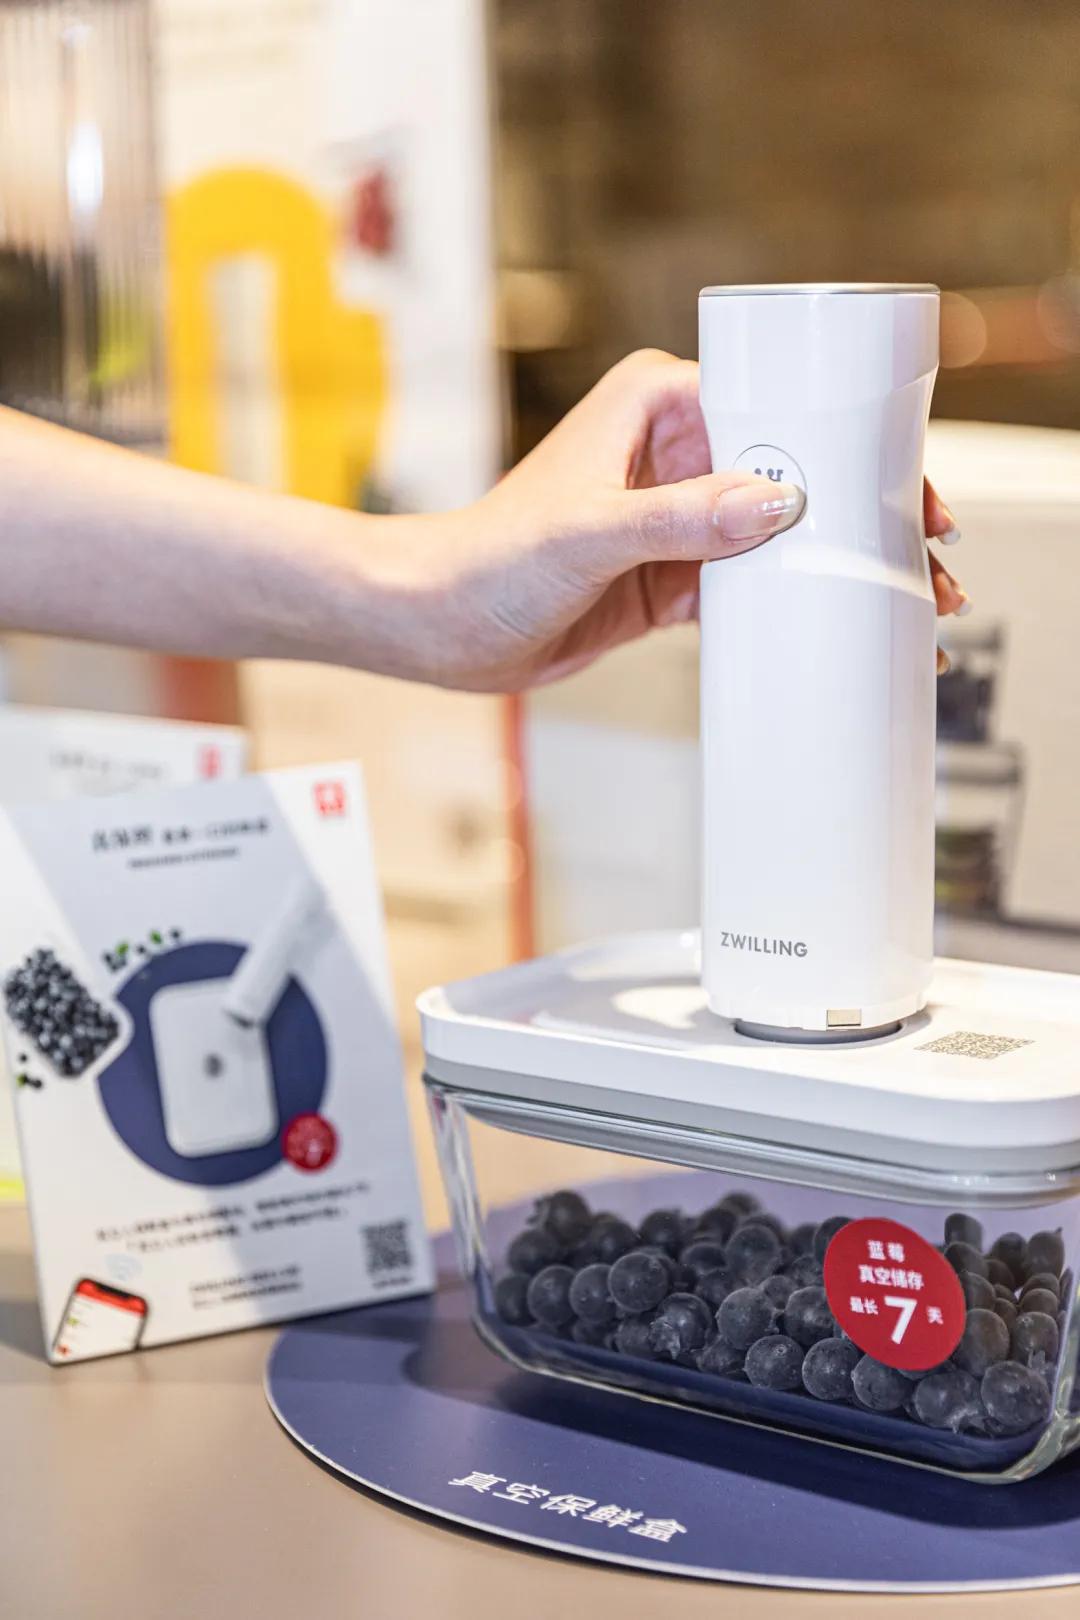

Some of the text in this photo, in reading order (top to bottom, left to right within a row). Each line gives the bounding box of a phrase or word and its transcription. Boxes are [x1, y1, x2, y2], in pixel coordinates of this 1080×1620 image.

[720, 931, 808, 957] ZWILLING
[866, 1240, 905, 1263] 蓝莓
[858, 1264, 925, 1291] 真空储存
[884, 1295, 918, 1345] 7
[448, 1471, 687, 1543] 真空保鲜盒
